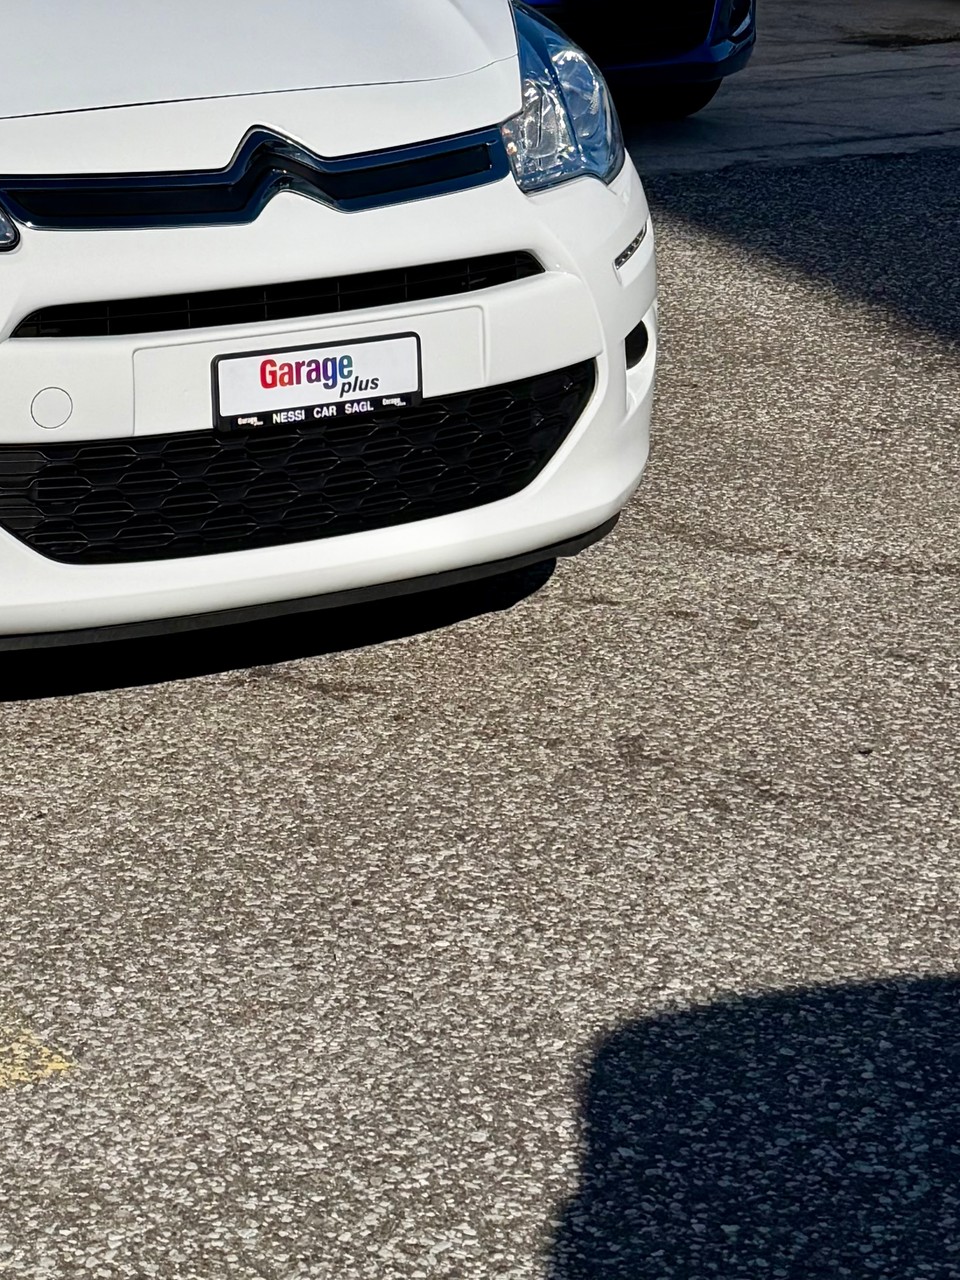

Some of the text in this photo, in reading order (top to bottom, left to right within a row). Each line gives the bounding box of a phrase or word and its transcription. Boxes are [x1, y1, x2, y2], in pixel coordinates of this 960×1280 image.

[260, 355, 353, 390] Garage
[339, 376, 380, 398] plus
[272, 401, 374, 424] NESSI CAR SAGL
